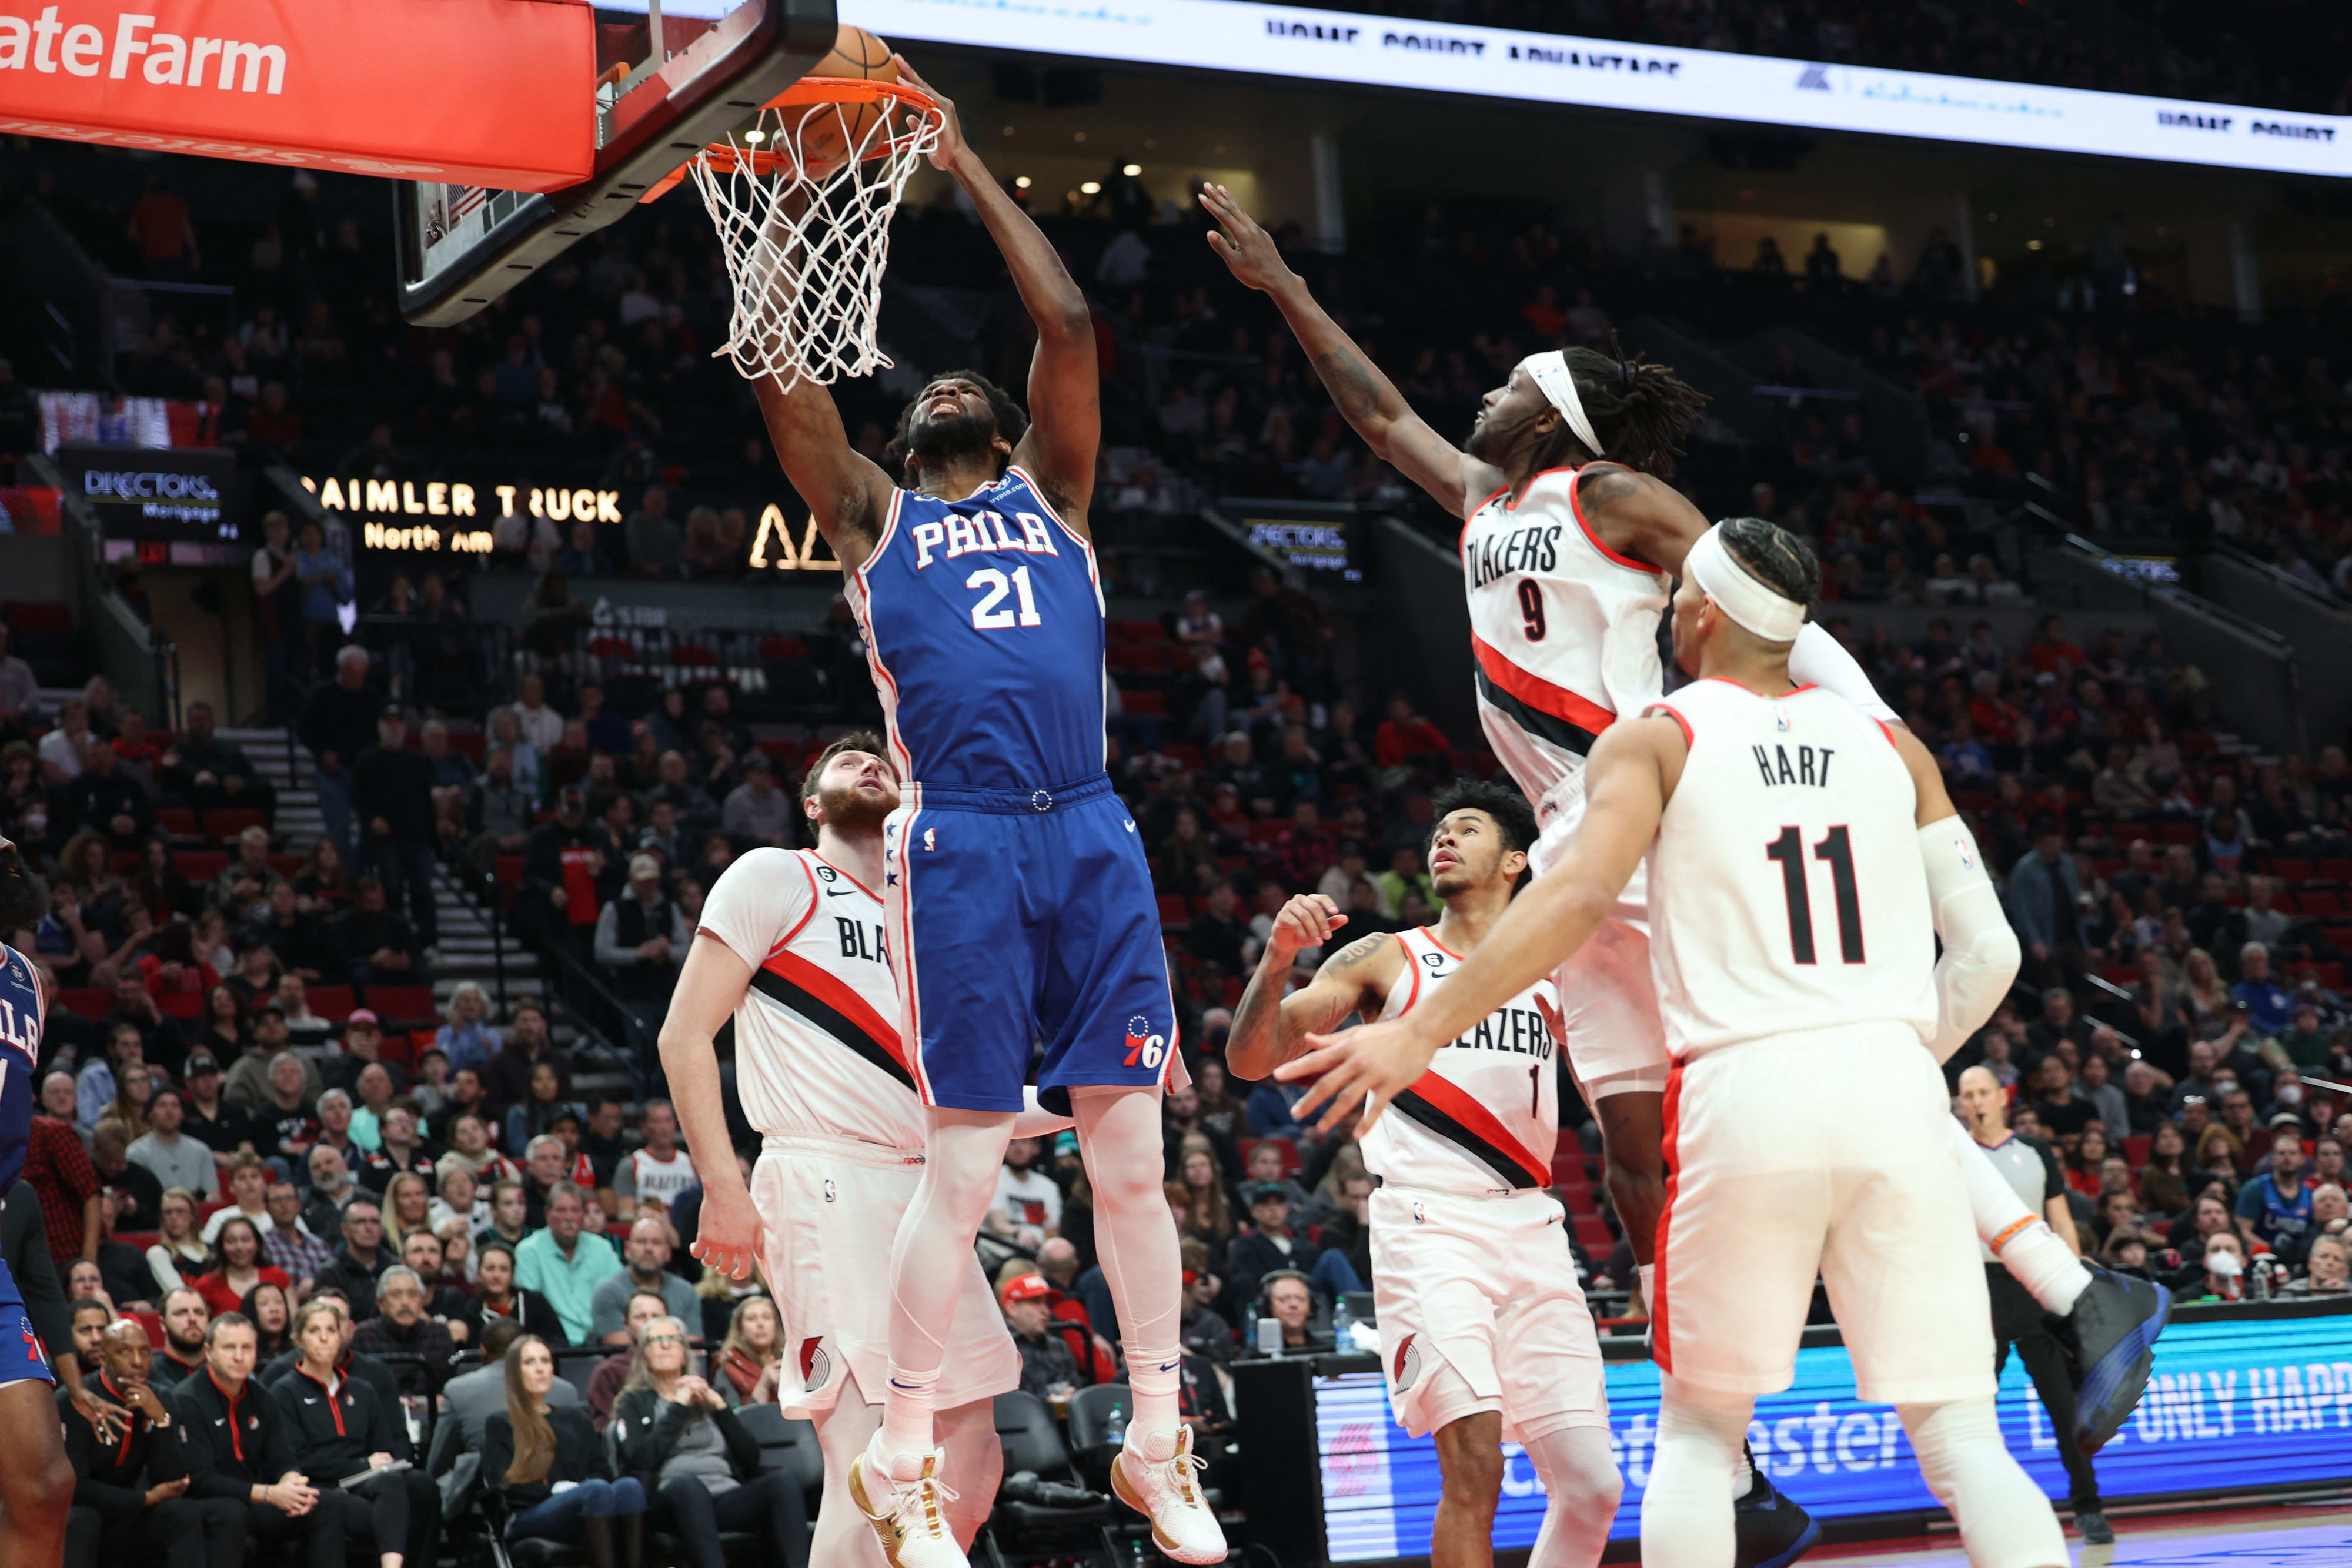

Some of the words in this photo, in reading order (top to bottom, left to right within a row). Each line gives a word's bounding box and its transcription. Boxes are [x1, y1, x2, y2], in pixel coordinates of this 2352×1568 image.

[300, 476, 477, 517] AIMLER
[912, 510, 1059, 571] PHILA
[965, 565, 1041, 629] 21
[1518, 577, 1546, 643] 9
[1752, 744, 1835, 788] HART
[1766, 824, 1866, 965] 11
[1122, 1033, 1164, 1069] 76
[1529, 1064, 1540, 1119] 1
[2134, 1370, 2237, 1443] ONLY
